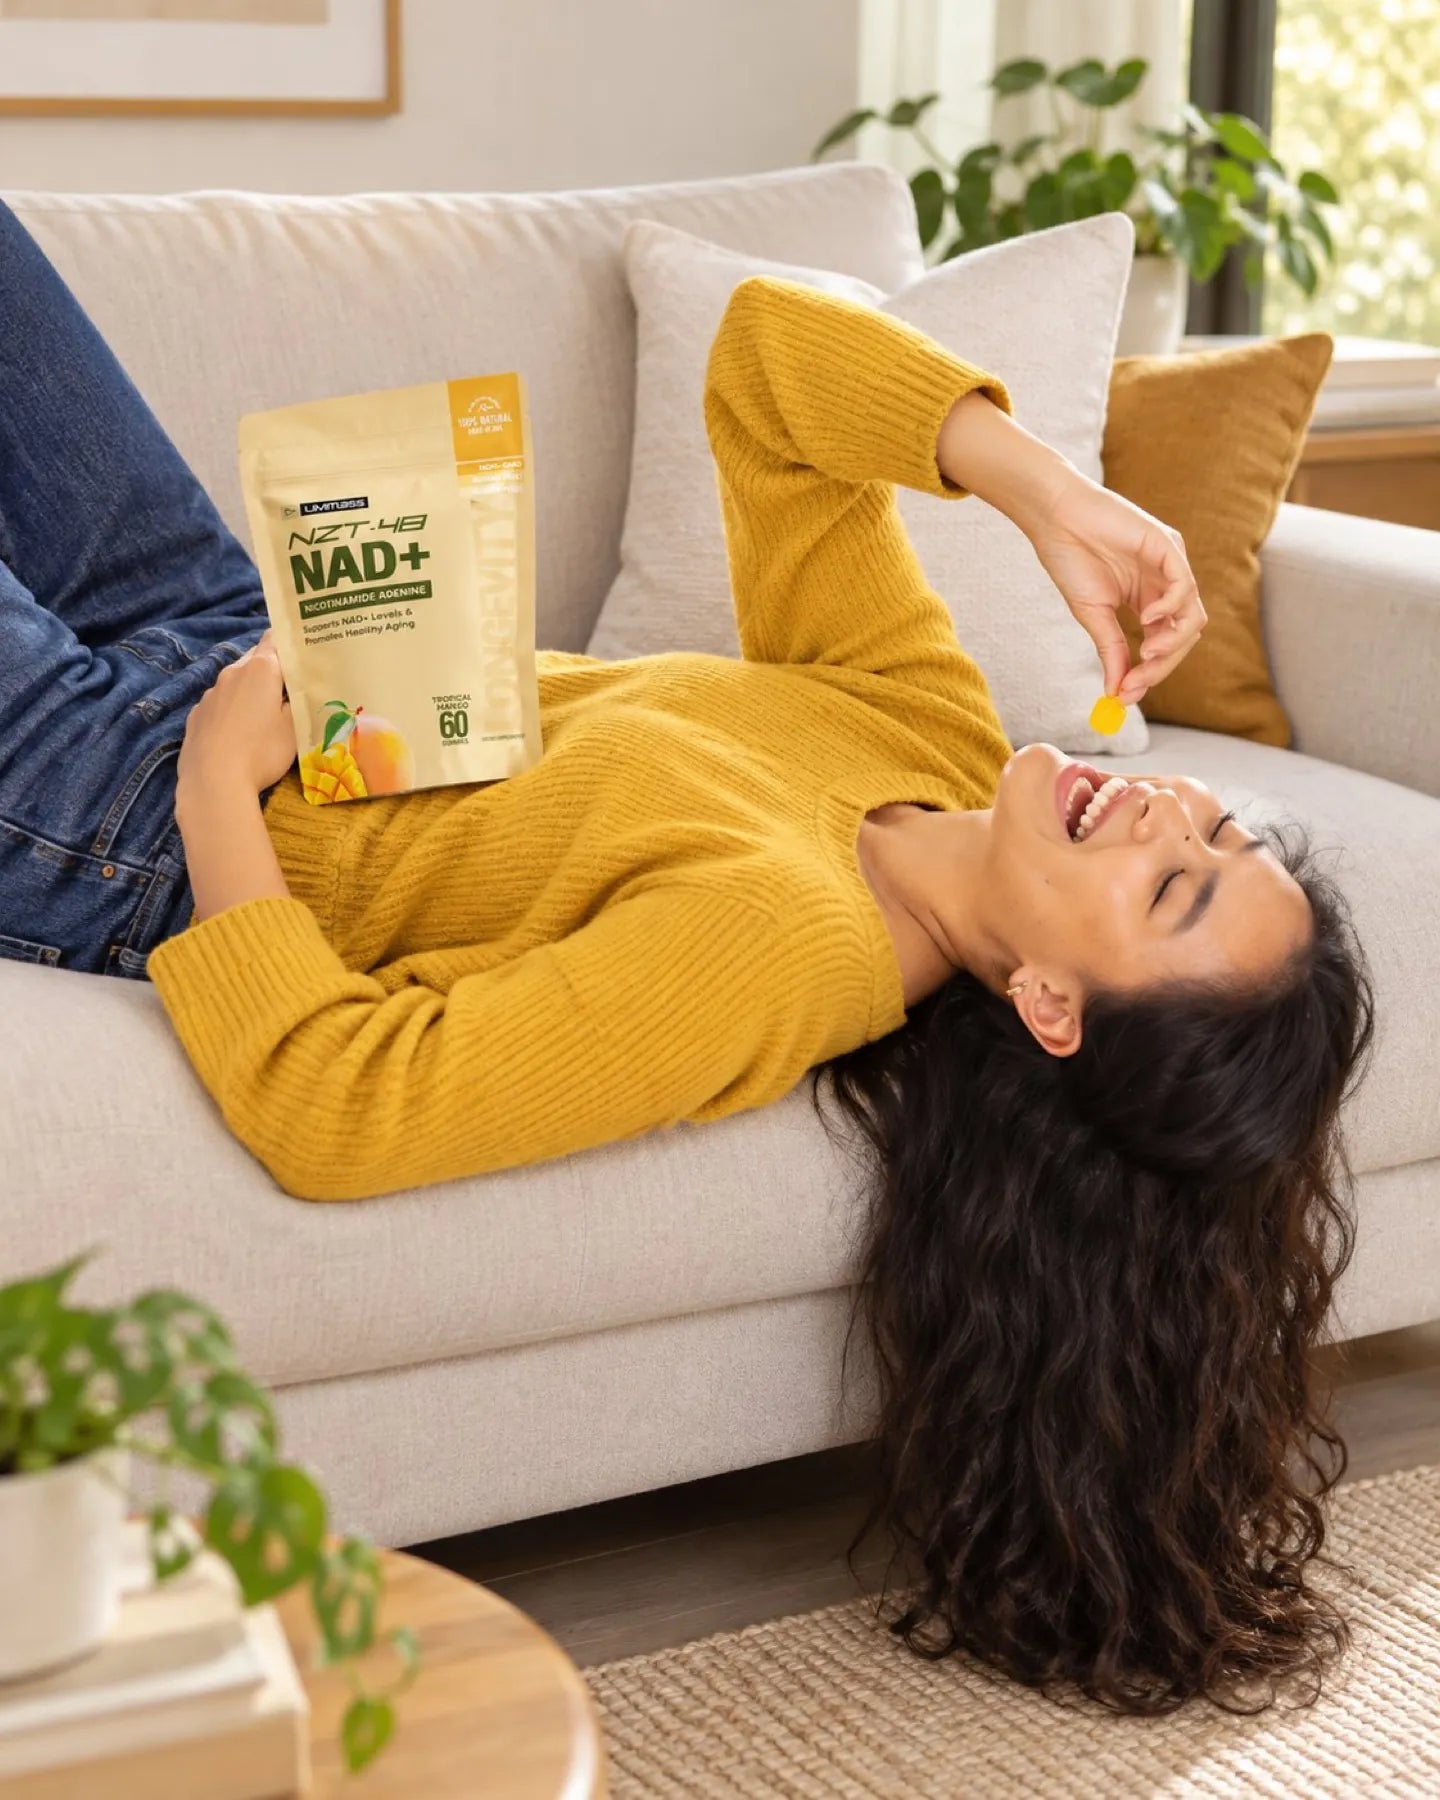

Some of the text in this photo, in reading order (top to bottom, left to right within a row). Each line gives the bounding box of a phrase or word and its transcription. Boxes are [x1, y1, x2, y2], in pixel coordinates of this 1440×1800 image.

[289, 514, 427, 550] NZT-48
[290, 540, 430, 595] NAD+
[304, 585, 427, 614] NICOTINAMIDE ADENINE
[303, 608, 413, 634] Supports NAD+ Levels &
[305, 620, 415, 646] Promotes Healthy Aging
[432, 694, 471, 703] TROPICAL
[437, 701, 469, 711] MANGO
[439, 709, 468, 738] 60
